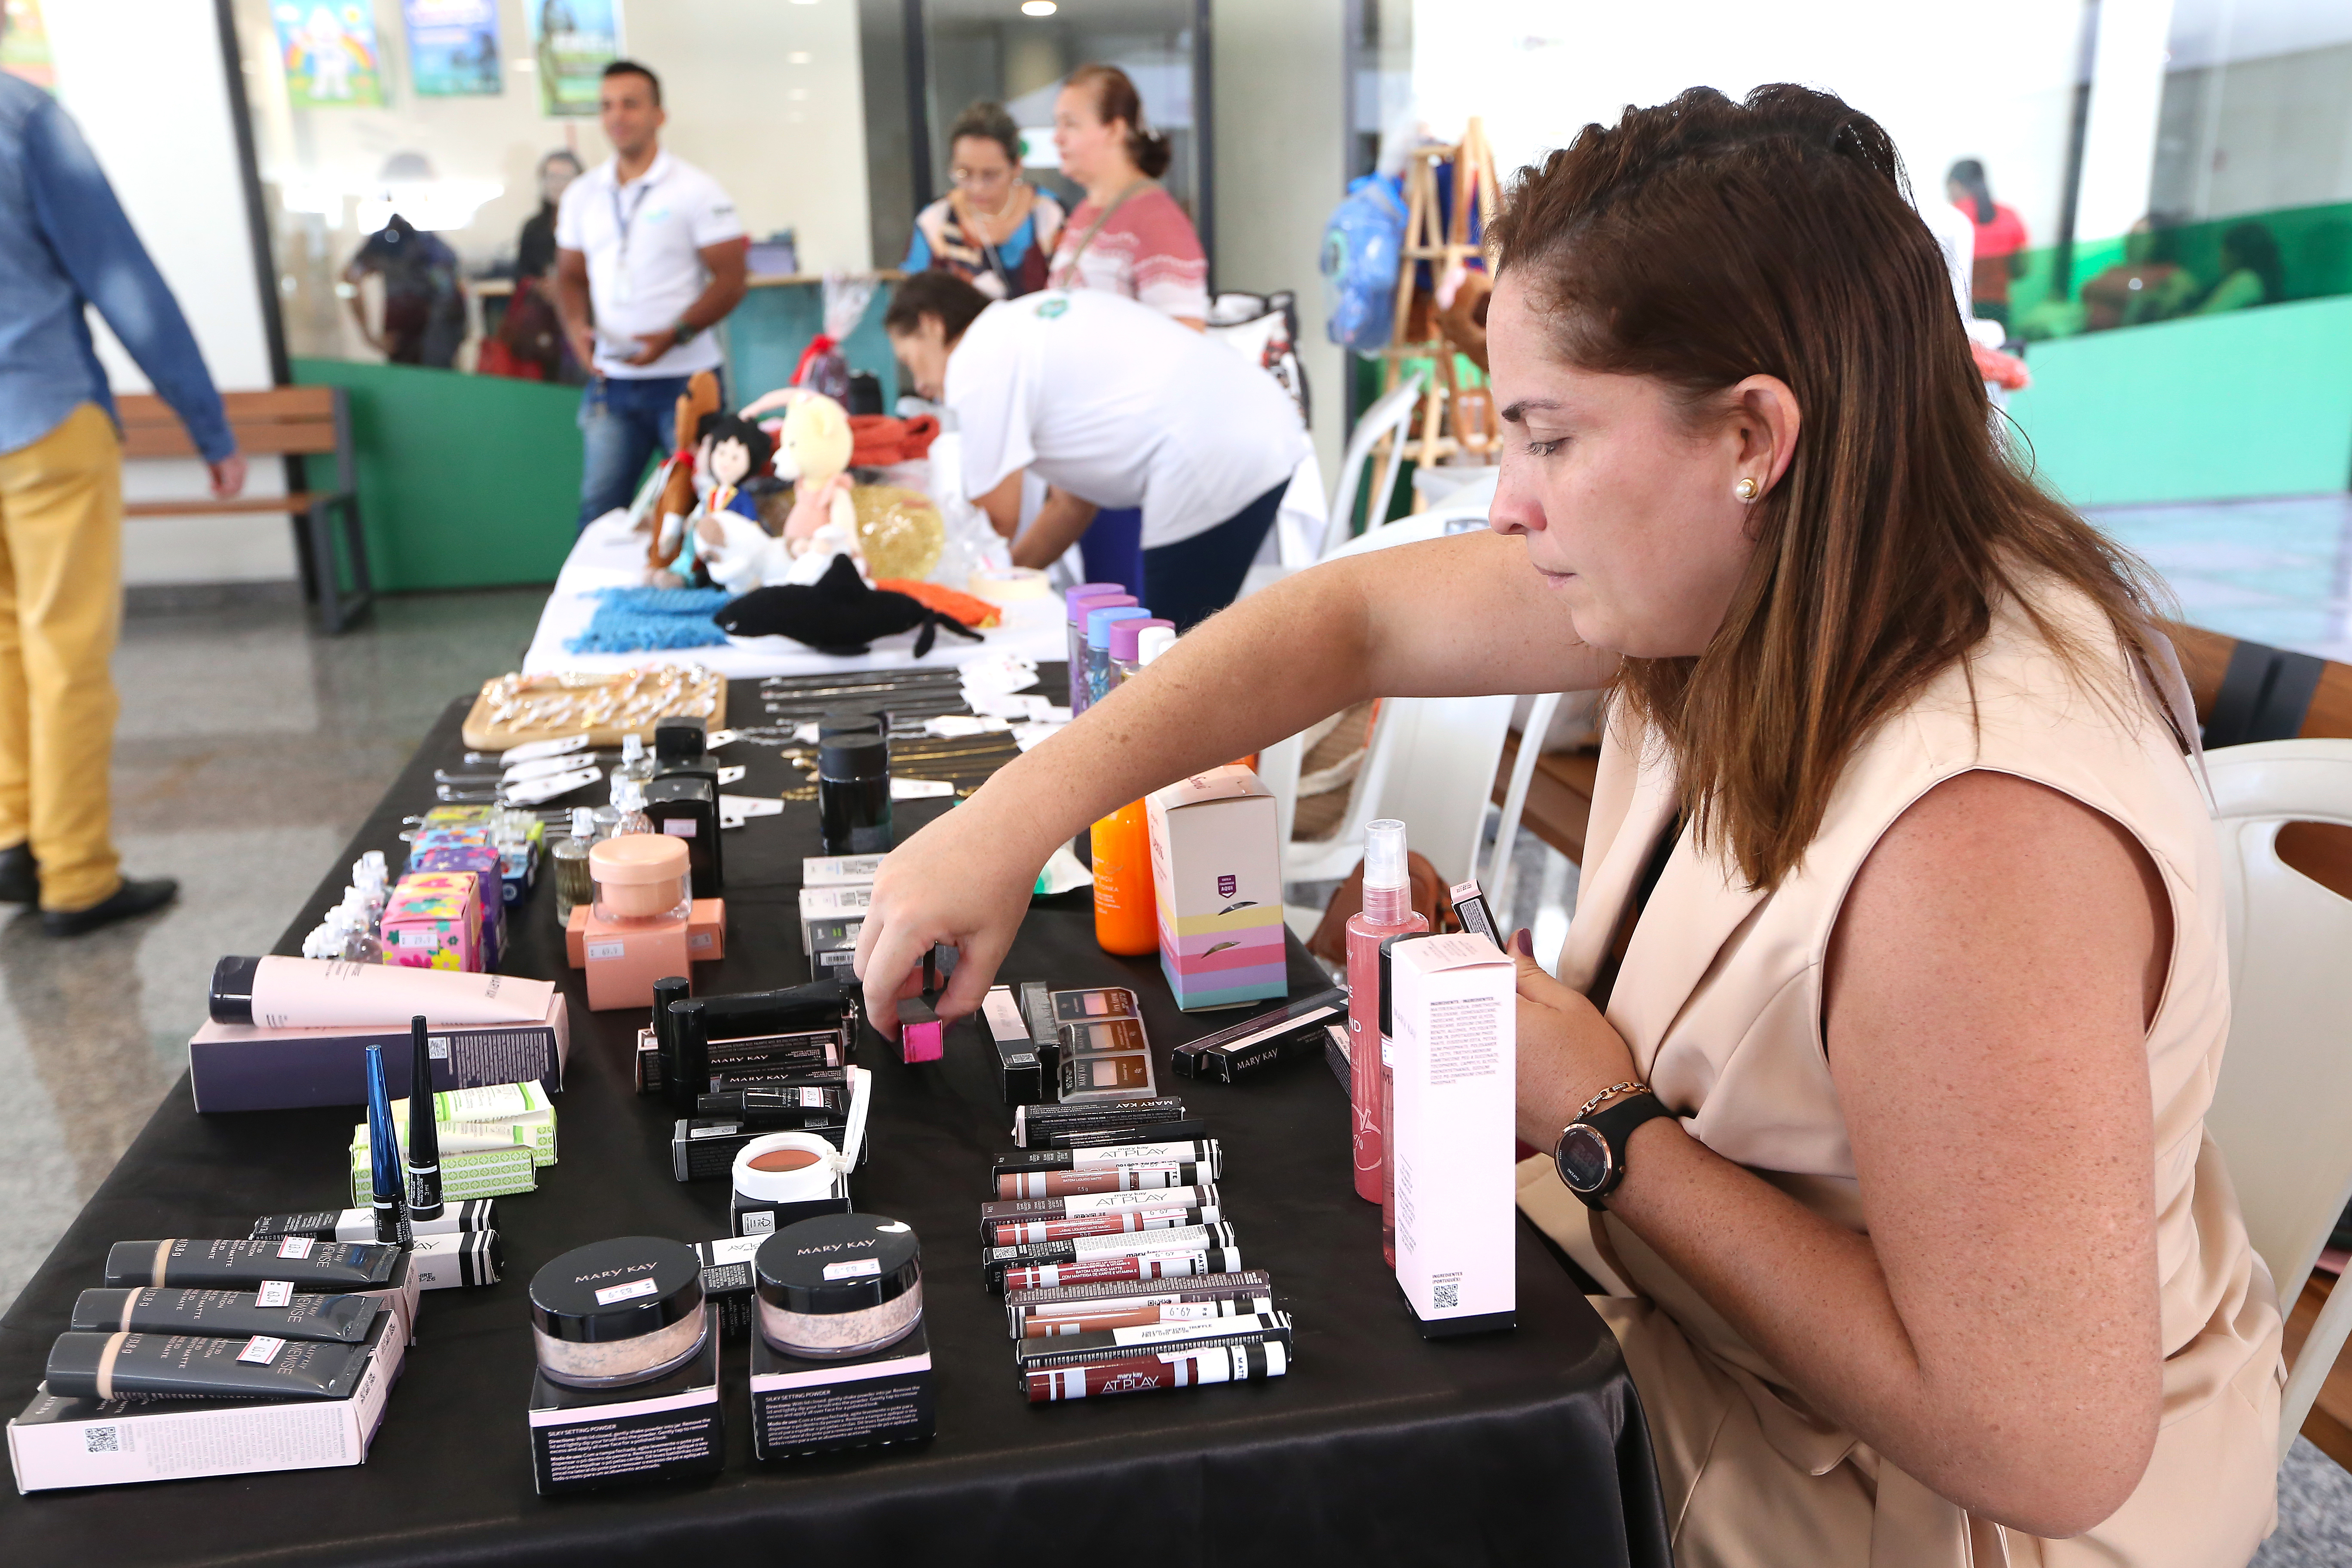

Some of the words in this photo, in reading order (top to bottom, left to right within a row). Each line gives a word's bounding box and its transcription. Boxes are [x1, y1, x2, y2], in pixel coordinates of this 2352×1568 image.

[1237, 1054, 1260, 1071] MARY
[1262, 1047, 1278, 1059] KAY
[1079, 1063, 1087, 1073] KAY
[1078, 1074, 1087, 1087] MARY
[1125, 1148, 1168, 1157] PLAY
[1567, 1168, 1580, 1182] XUFENG
[1096, 1198, 1118, 1207] AT
[1122, 1193, 1167, 1204] PLAY
[395, 1221, 404, 1243] SAPPHIRE
[208, 1246, 217, 1260] MATE
[287, 1243, 301, 1254] 63.9
[796, 1243, 843, 1256] MARY
[846, 1238, 876, 1250] KAY
[226, 1249, 236, 1268] MATTE
[334, 1253, 344, 1262] KAY
[575, 1268, 623, 1283] MARY
[626, 1261, 658, 1273] KAY
[266, 1290, 280, 1303] 63.9
[314, 1293, 325, 1307] MARY
[176, 1298, 186, 1311] MATE
[193, 1300, 205, 1320] MATTE
[308, 1305, 318, 1317] KAY
[1169, 1307, 1190, 1317] 49.9
[160, 1347, 171, 1359] MATE
[249, 1346, 266, 1358] 63.9
[306, 1344, 318, 1359] MARY
[178, 1350, 190, 1369] MATTE
[298, 1358, 310, 1370] KAY
[1102, 1380, 1120, 1392] AT
[1123, 1375, 1159, 1390] PLAY
